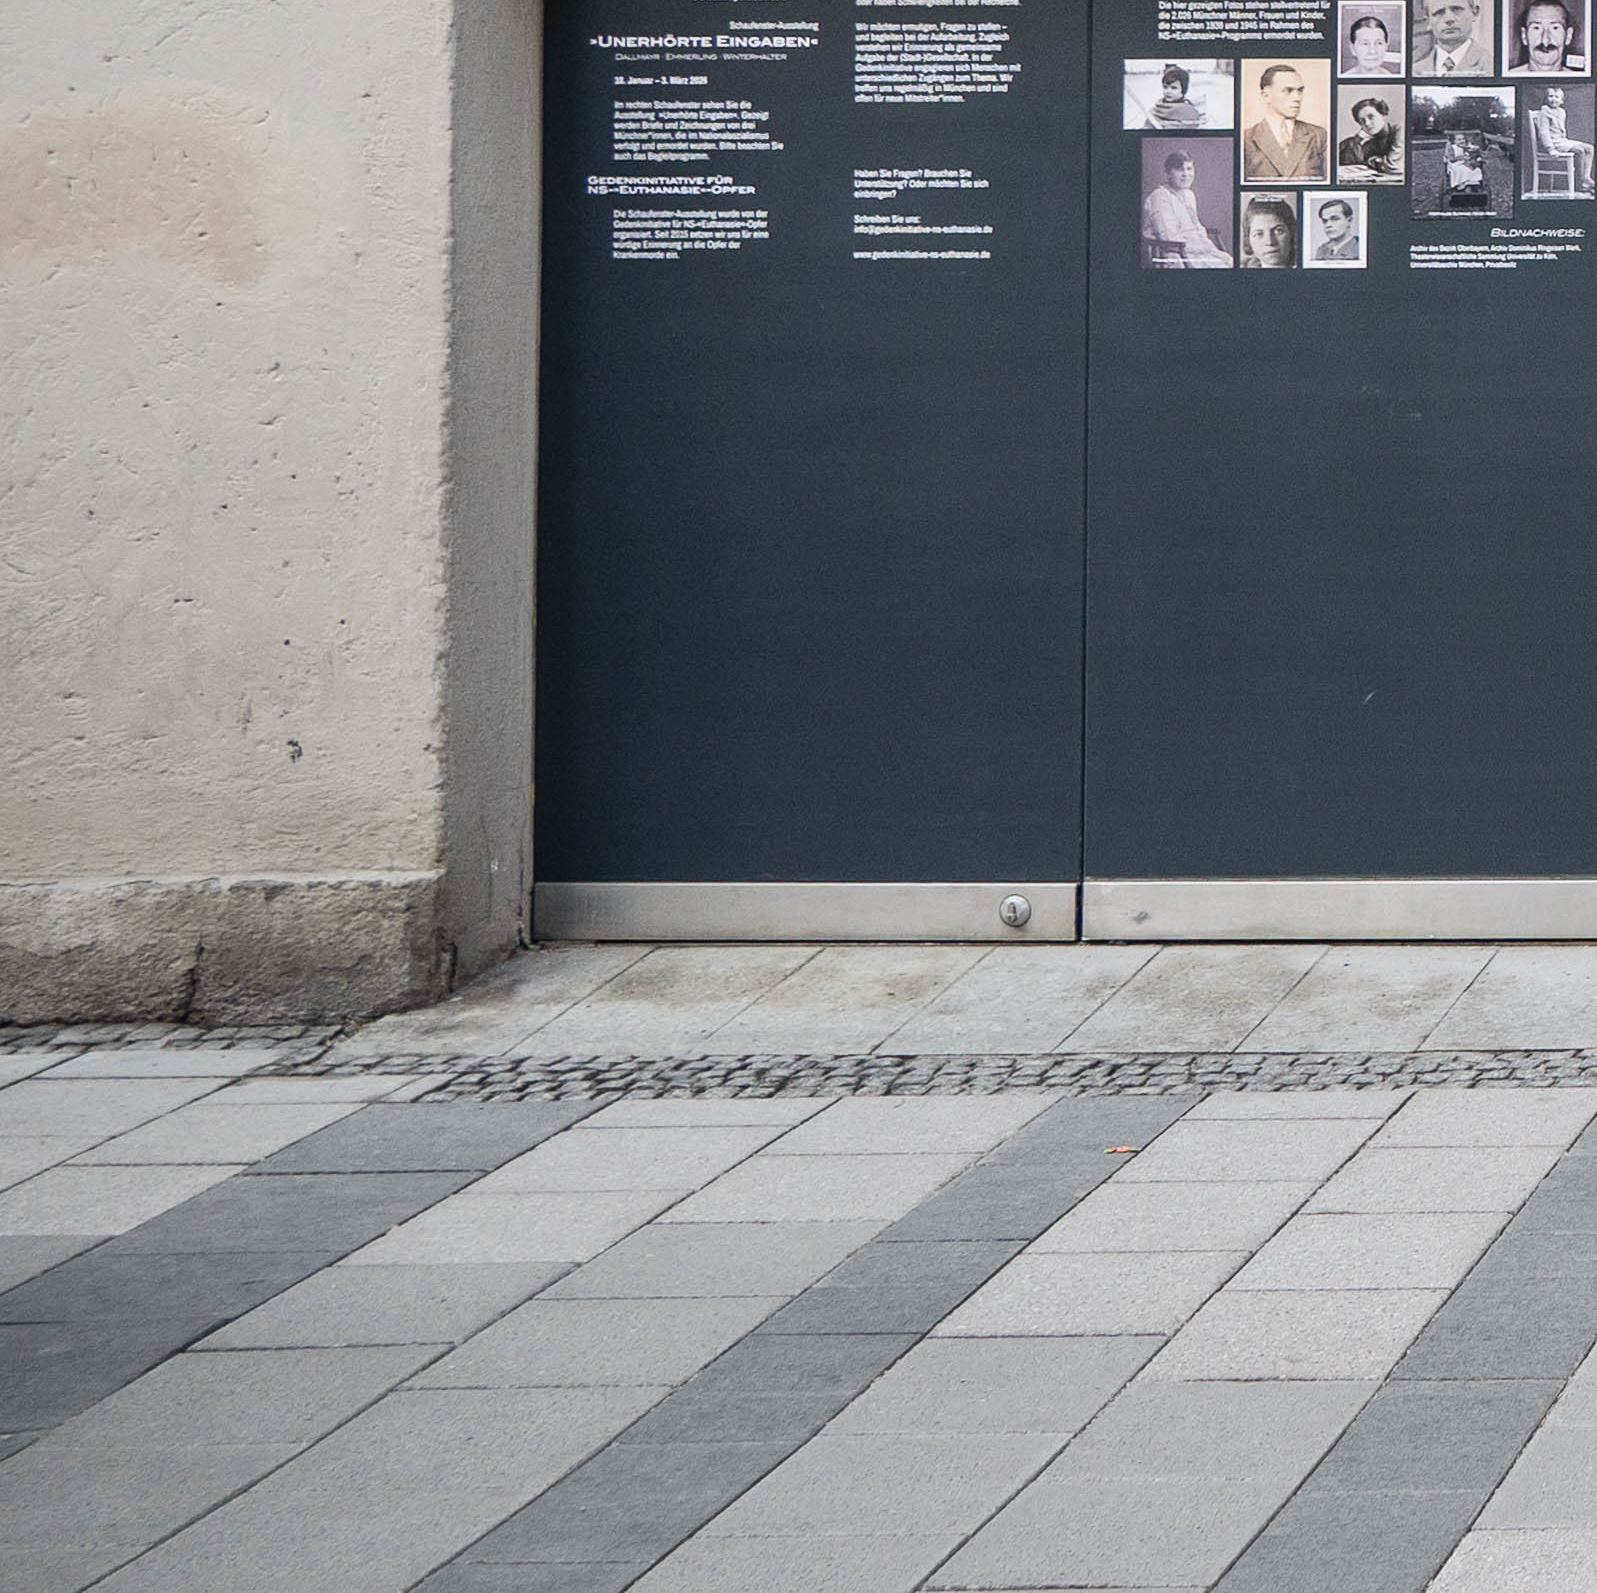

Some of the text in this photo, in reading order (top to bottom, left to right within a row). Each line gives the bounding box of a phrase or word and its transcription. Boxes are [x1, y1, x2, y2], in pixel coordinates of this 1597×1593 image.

[590, 34, 818, 48] »UNERHÖRTE EINGABEN«
[587, 174, 733, 184] GEDENKINITIATIVE FÜR
